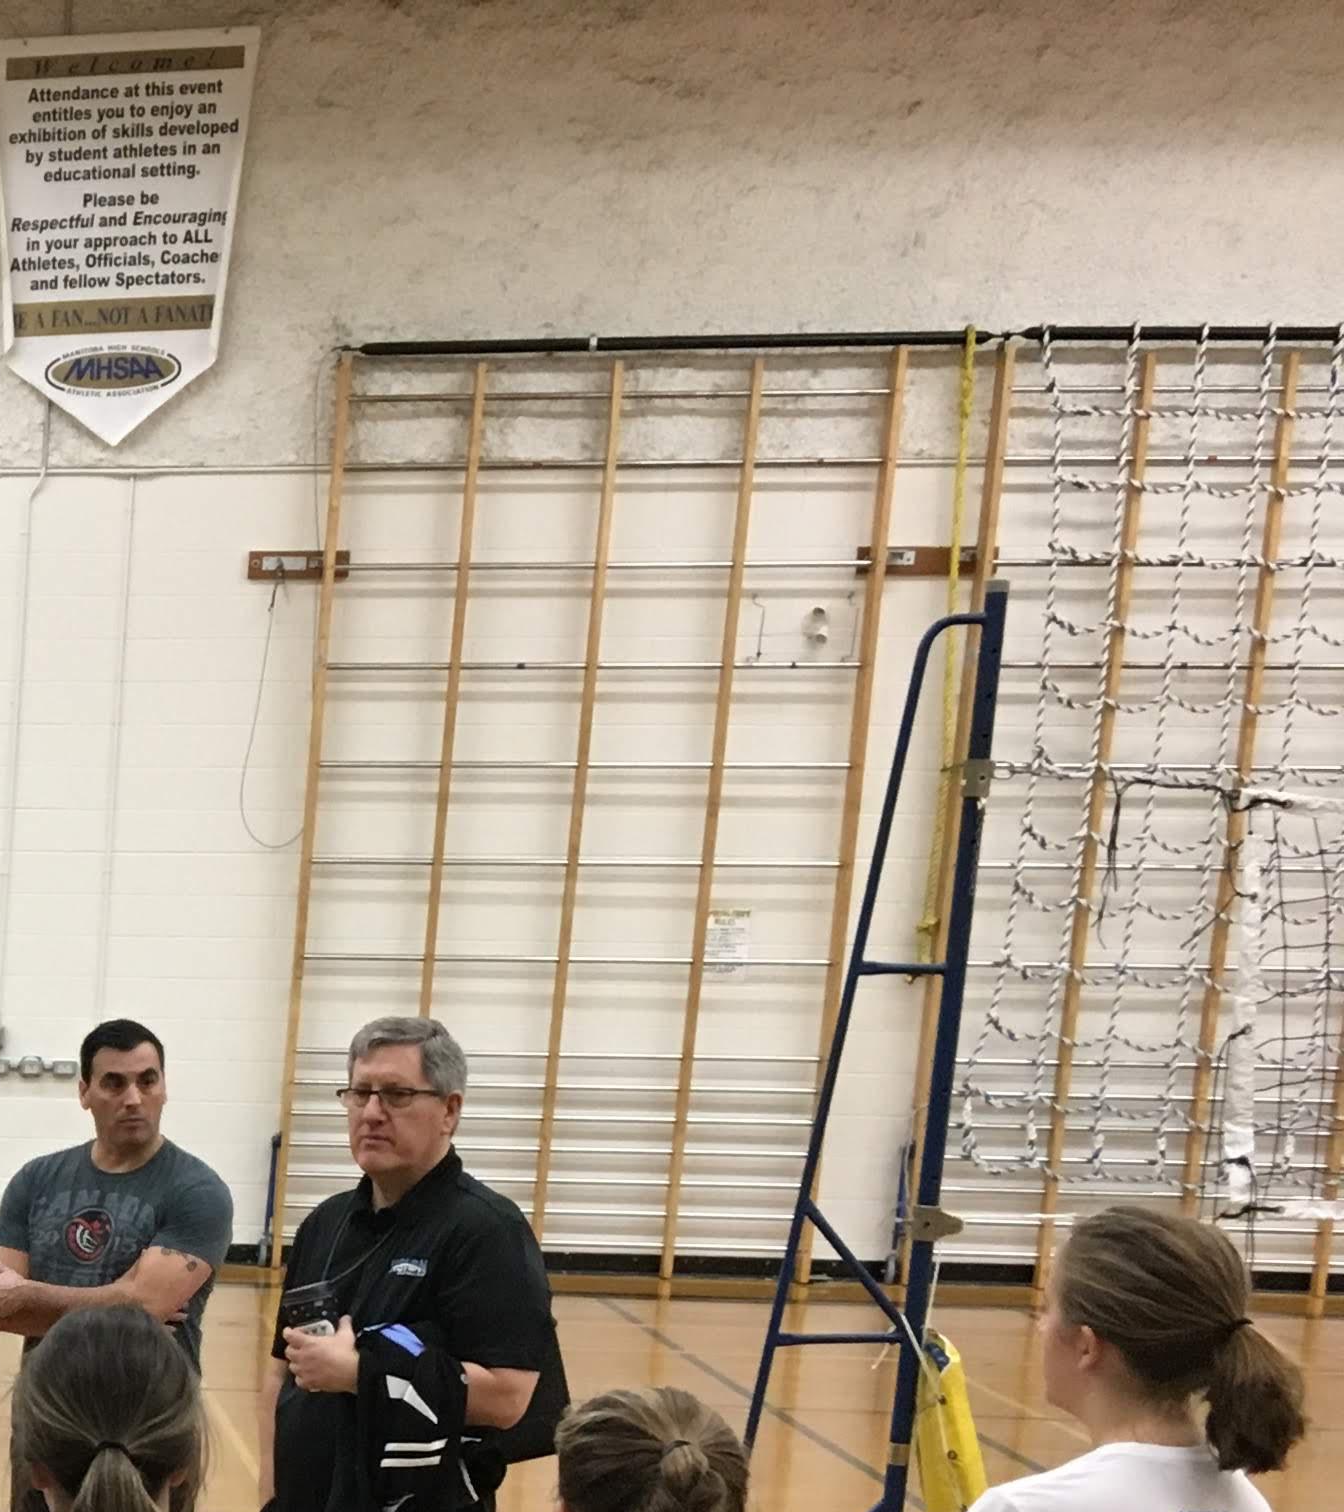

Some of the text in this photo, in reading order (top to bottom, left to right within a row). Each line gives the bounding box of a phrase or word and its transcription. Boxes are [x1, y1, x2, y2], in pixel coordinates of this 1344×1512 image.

[28, 80, 223, 103] Attendance at this event
[32, 102, 216, 125] entitles you to enjoy an
[9, 119, 239, 144] exhibition of skills developed
[25, 142, 220, 167] by student athletes in an
[44, 162, 200, 182] educational setting.
[83, 191, 159, 208] Please be
[10, 214, 95, 234] Respectful
[99, 212, 127, 227] and
[27, 229, 213, 254] in your approach to ALL
[10, 249, 221, 274] Athletes, Officials, Coache
[30, 270, 205, 291] and fellow Spectators.
[63, 355, 164, 383] MHSAA
